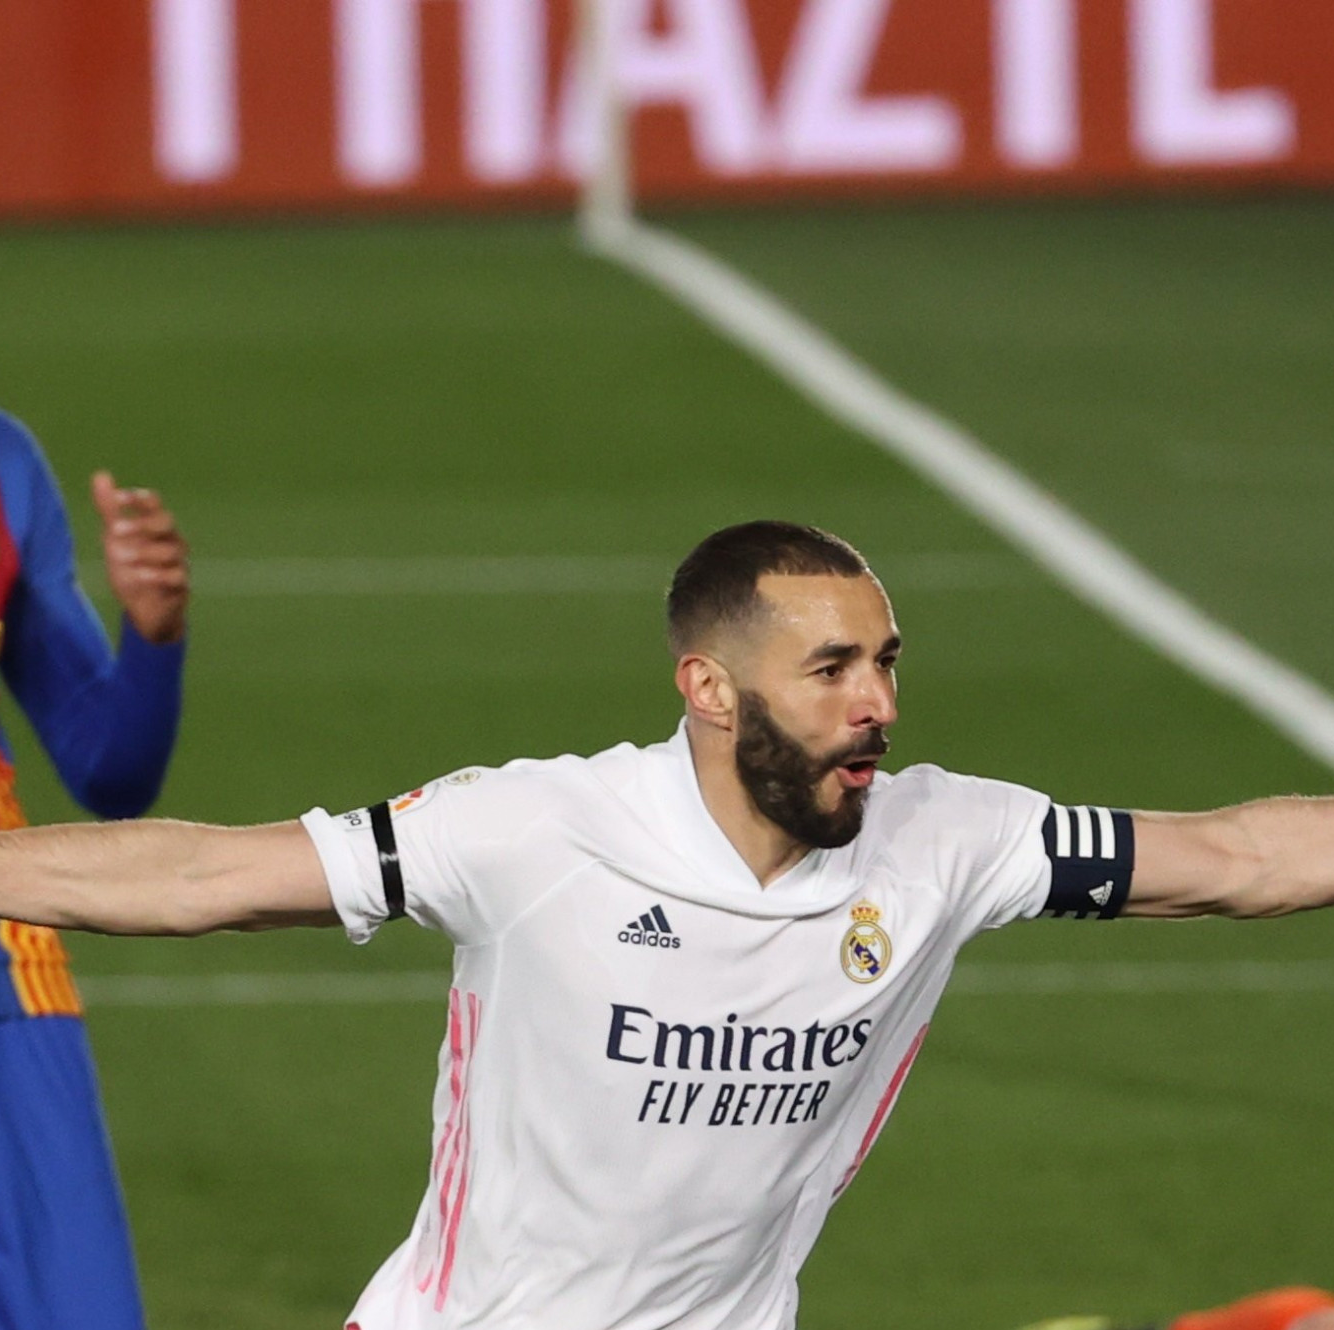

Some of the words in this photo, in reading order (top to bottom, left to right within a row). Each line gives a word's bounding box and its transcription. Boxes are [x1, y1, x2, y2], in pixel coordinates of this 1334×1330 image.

[617, 930, 681, 949] adidas
[606, 1003, 872, 1072] Emirates
[638, 1080, 704, 1125] FLY
[707, 1080, 830, 1126] BETTER
